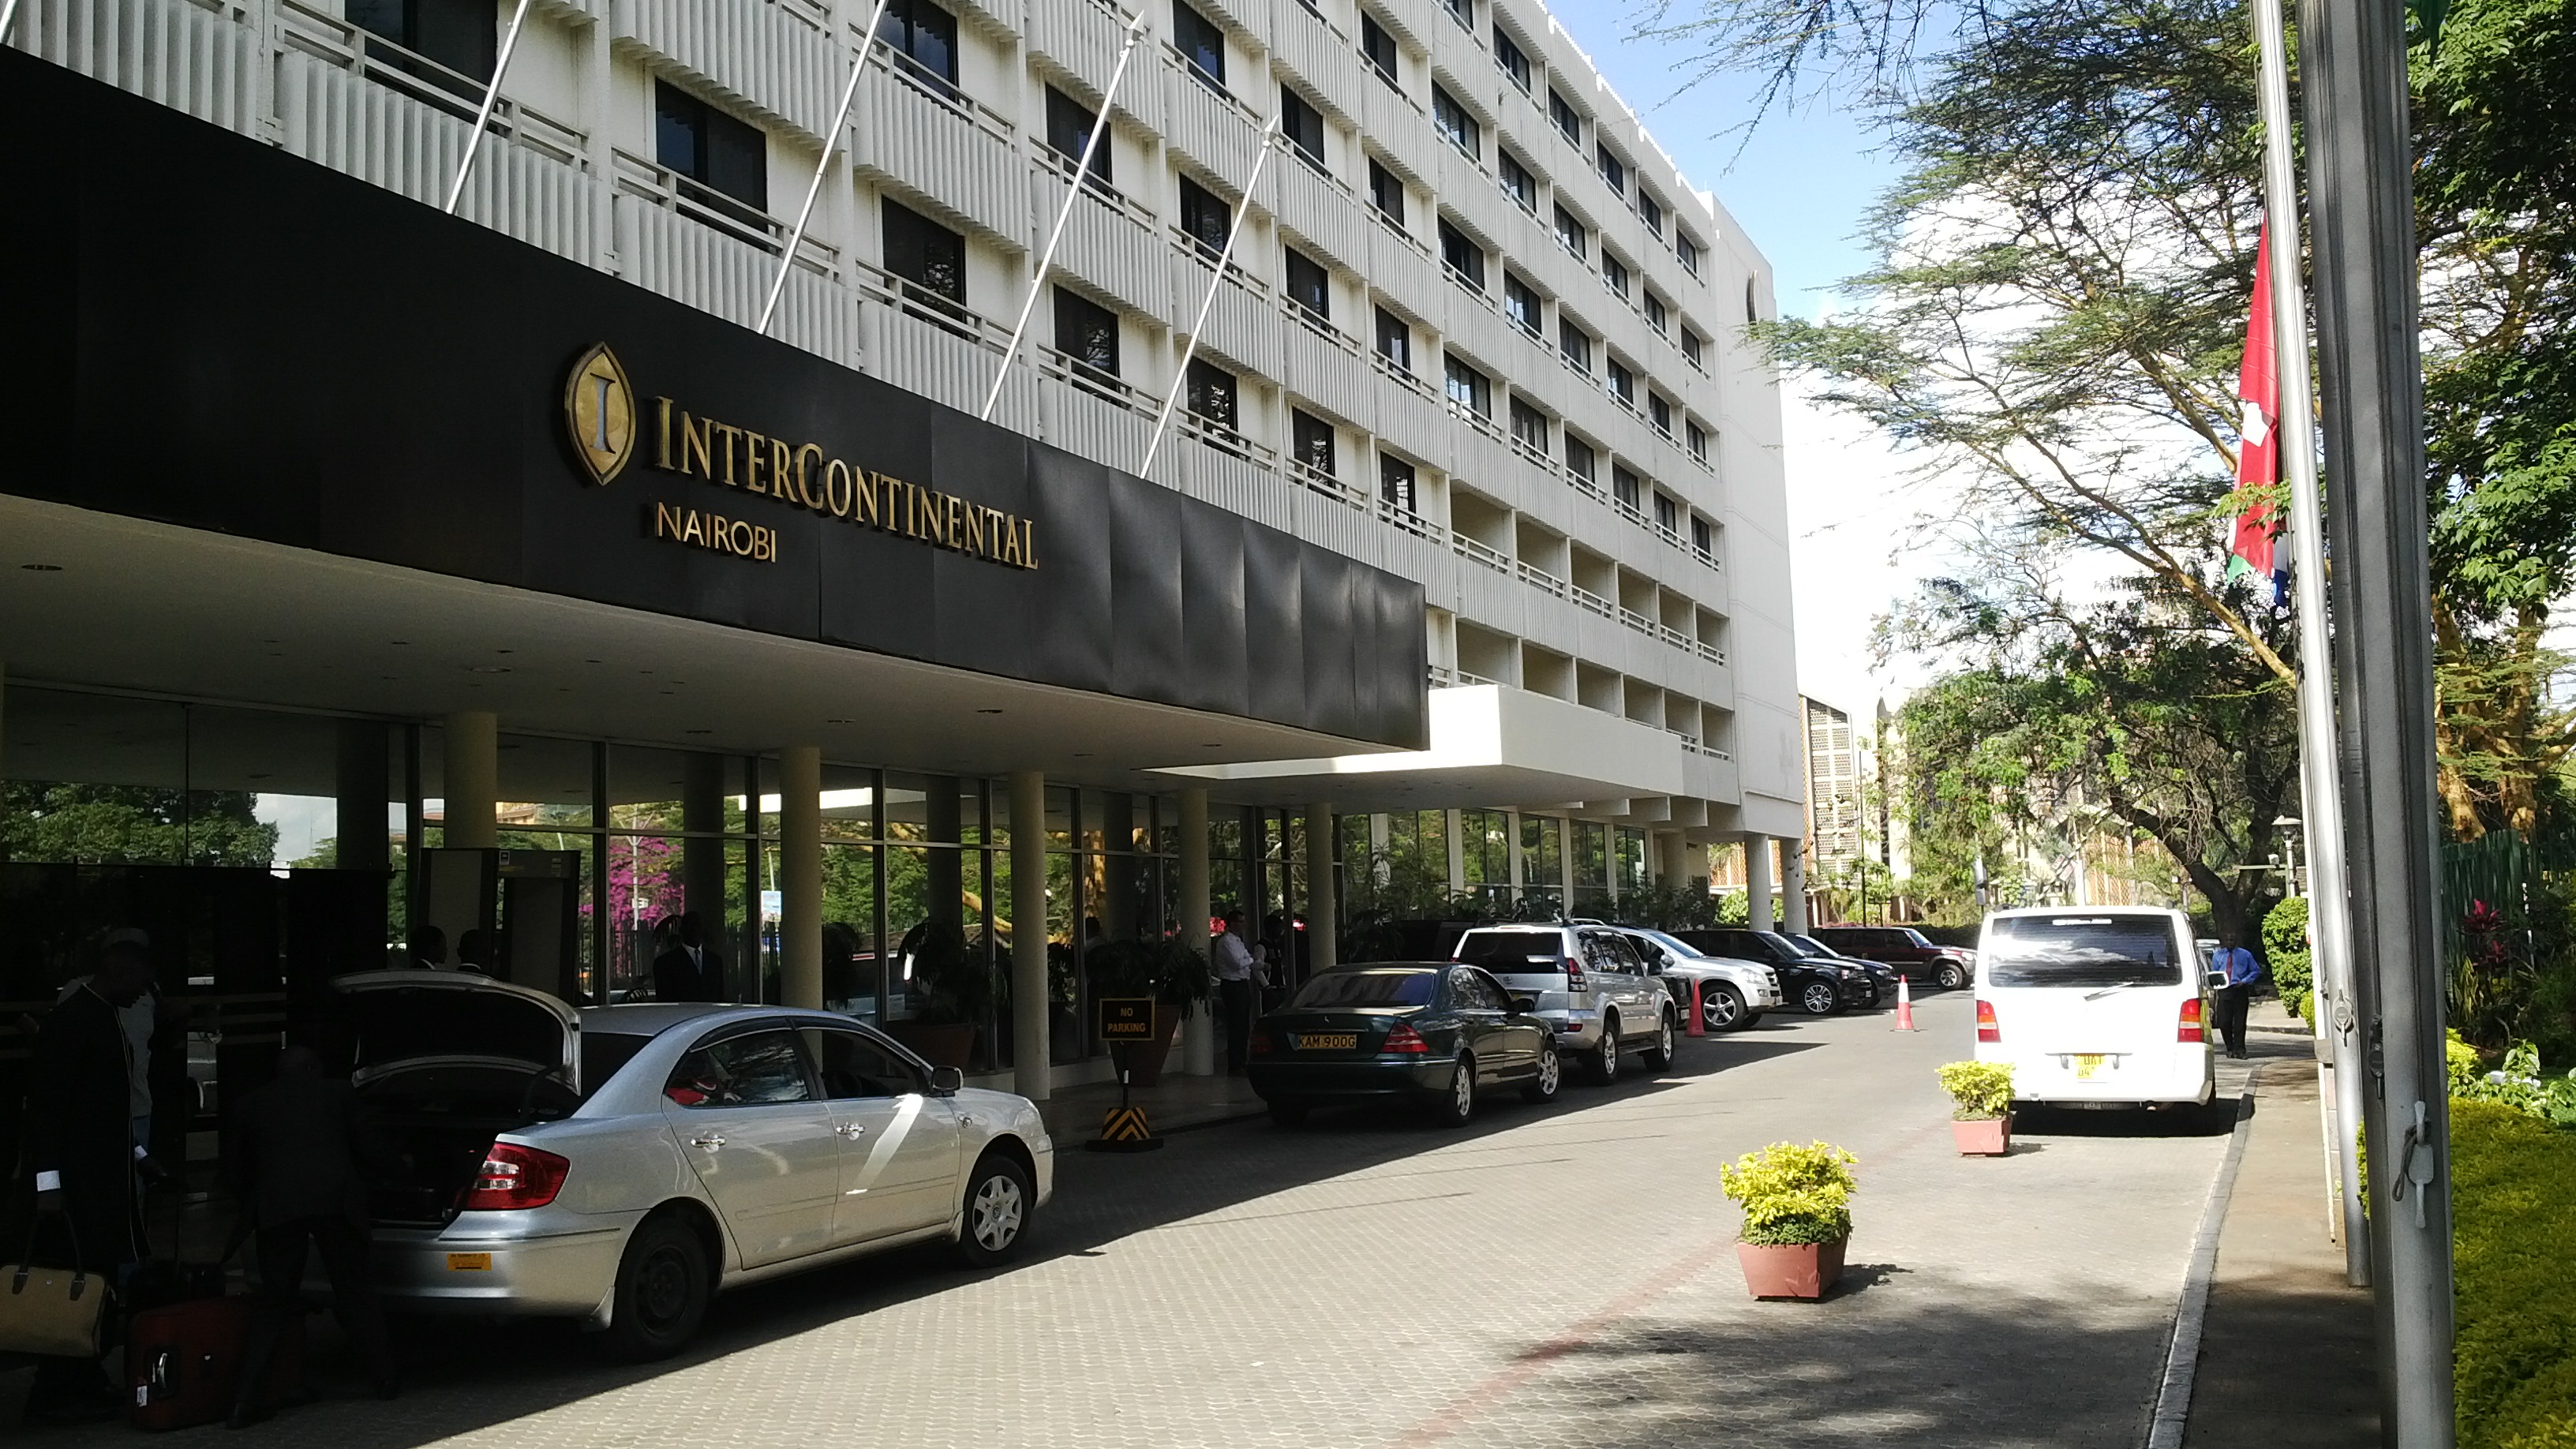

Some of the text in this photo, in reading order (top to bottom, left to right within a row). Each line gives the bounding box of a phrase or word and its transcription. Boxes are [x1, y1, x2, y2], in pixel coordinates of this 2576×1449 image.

[657, 501, 776, 563] NAIROBI
[1121, 1007, 1133, 1017] NO
[1107, 1022, 1146, 1032] PARKING
[1299, 1036, 1356, 1048] KAM 900G
